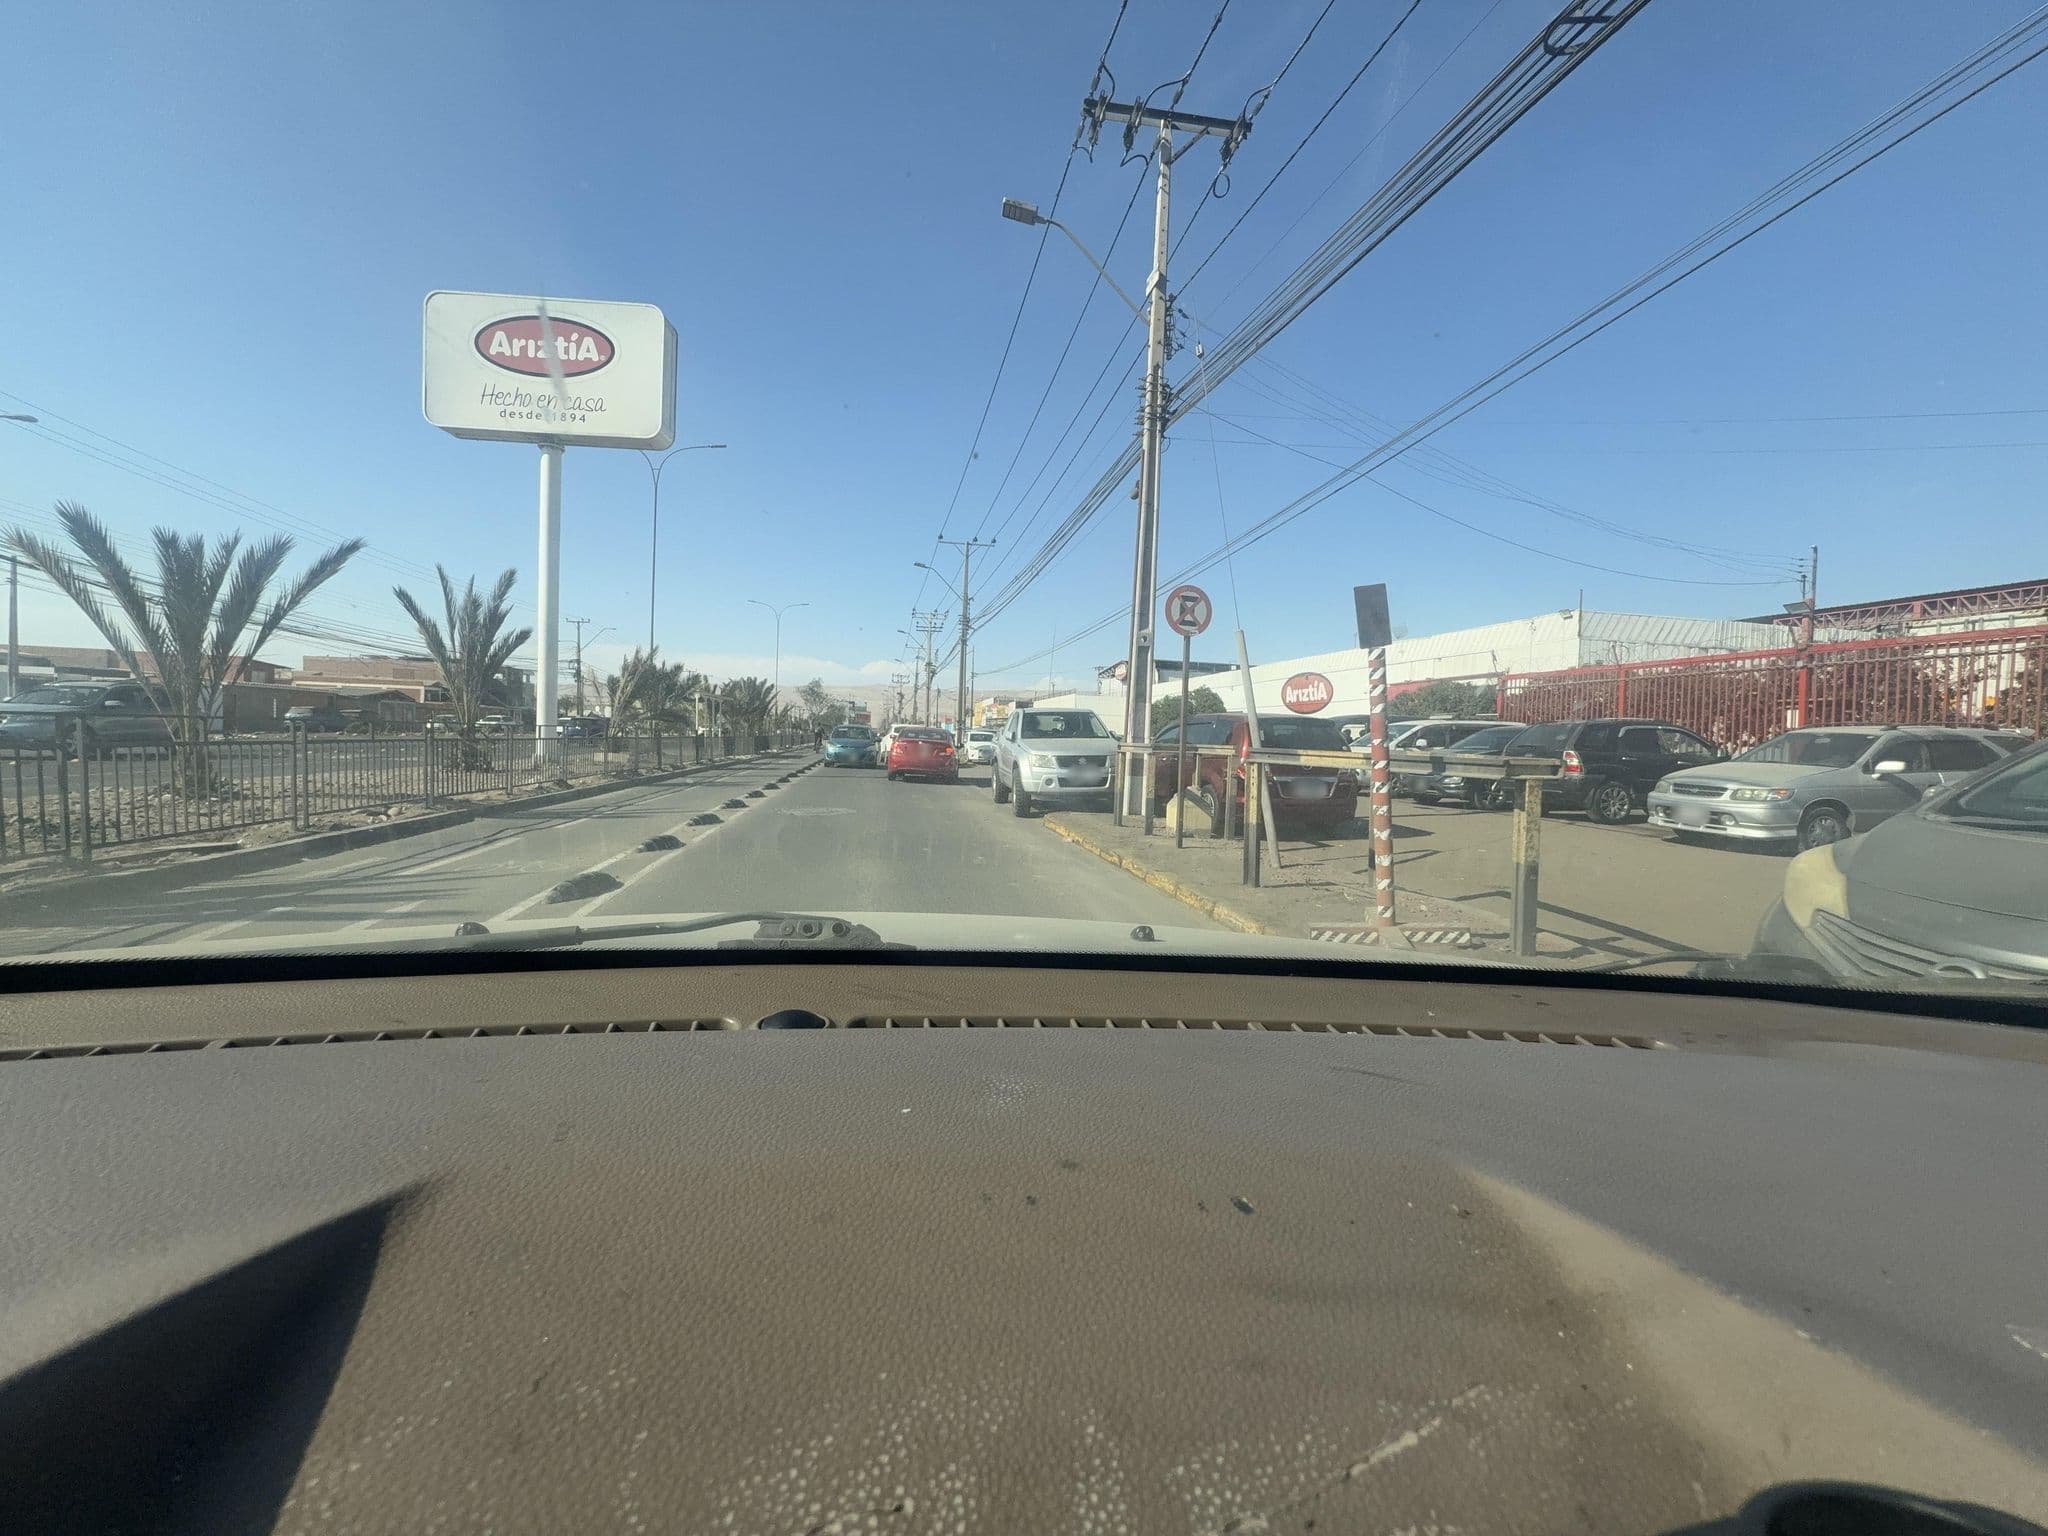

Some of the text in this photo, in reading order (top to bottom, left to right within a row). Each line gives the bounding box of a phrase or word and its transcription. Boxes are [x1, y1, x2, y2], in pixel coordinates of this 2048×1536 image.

[481, 383, 606, 412] Hecho en casa
[499, 409, 586, 423] desde 1894
